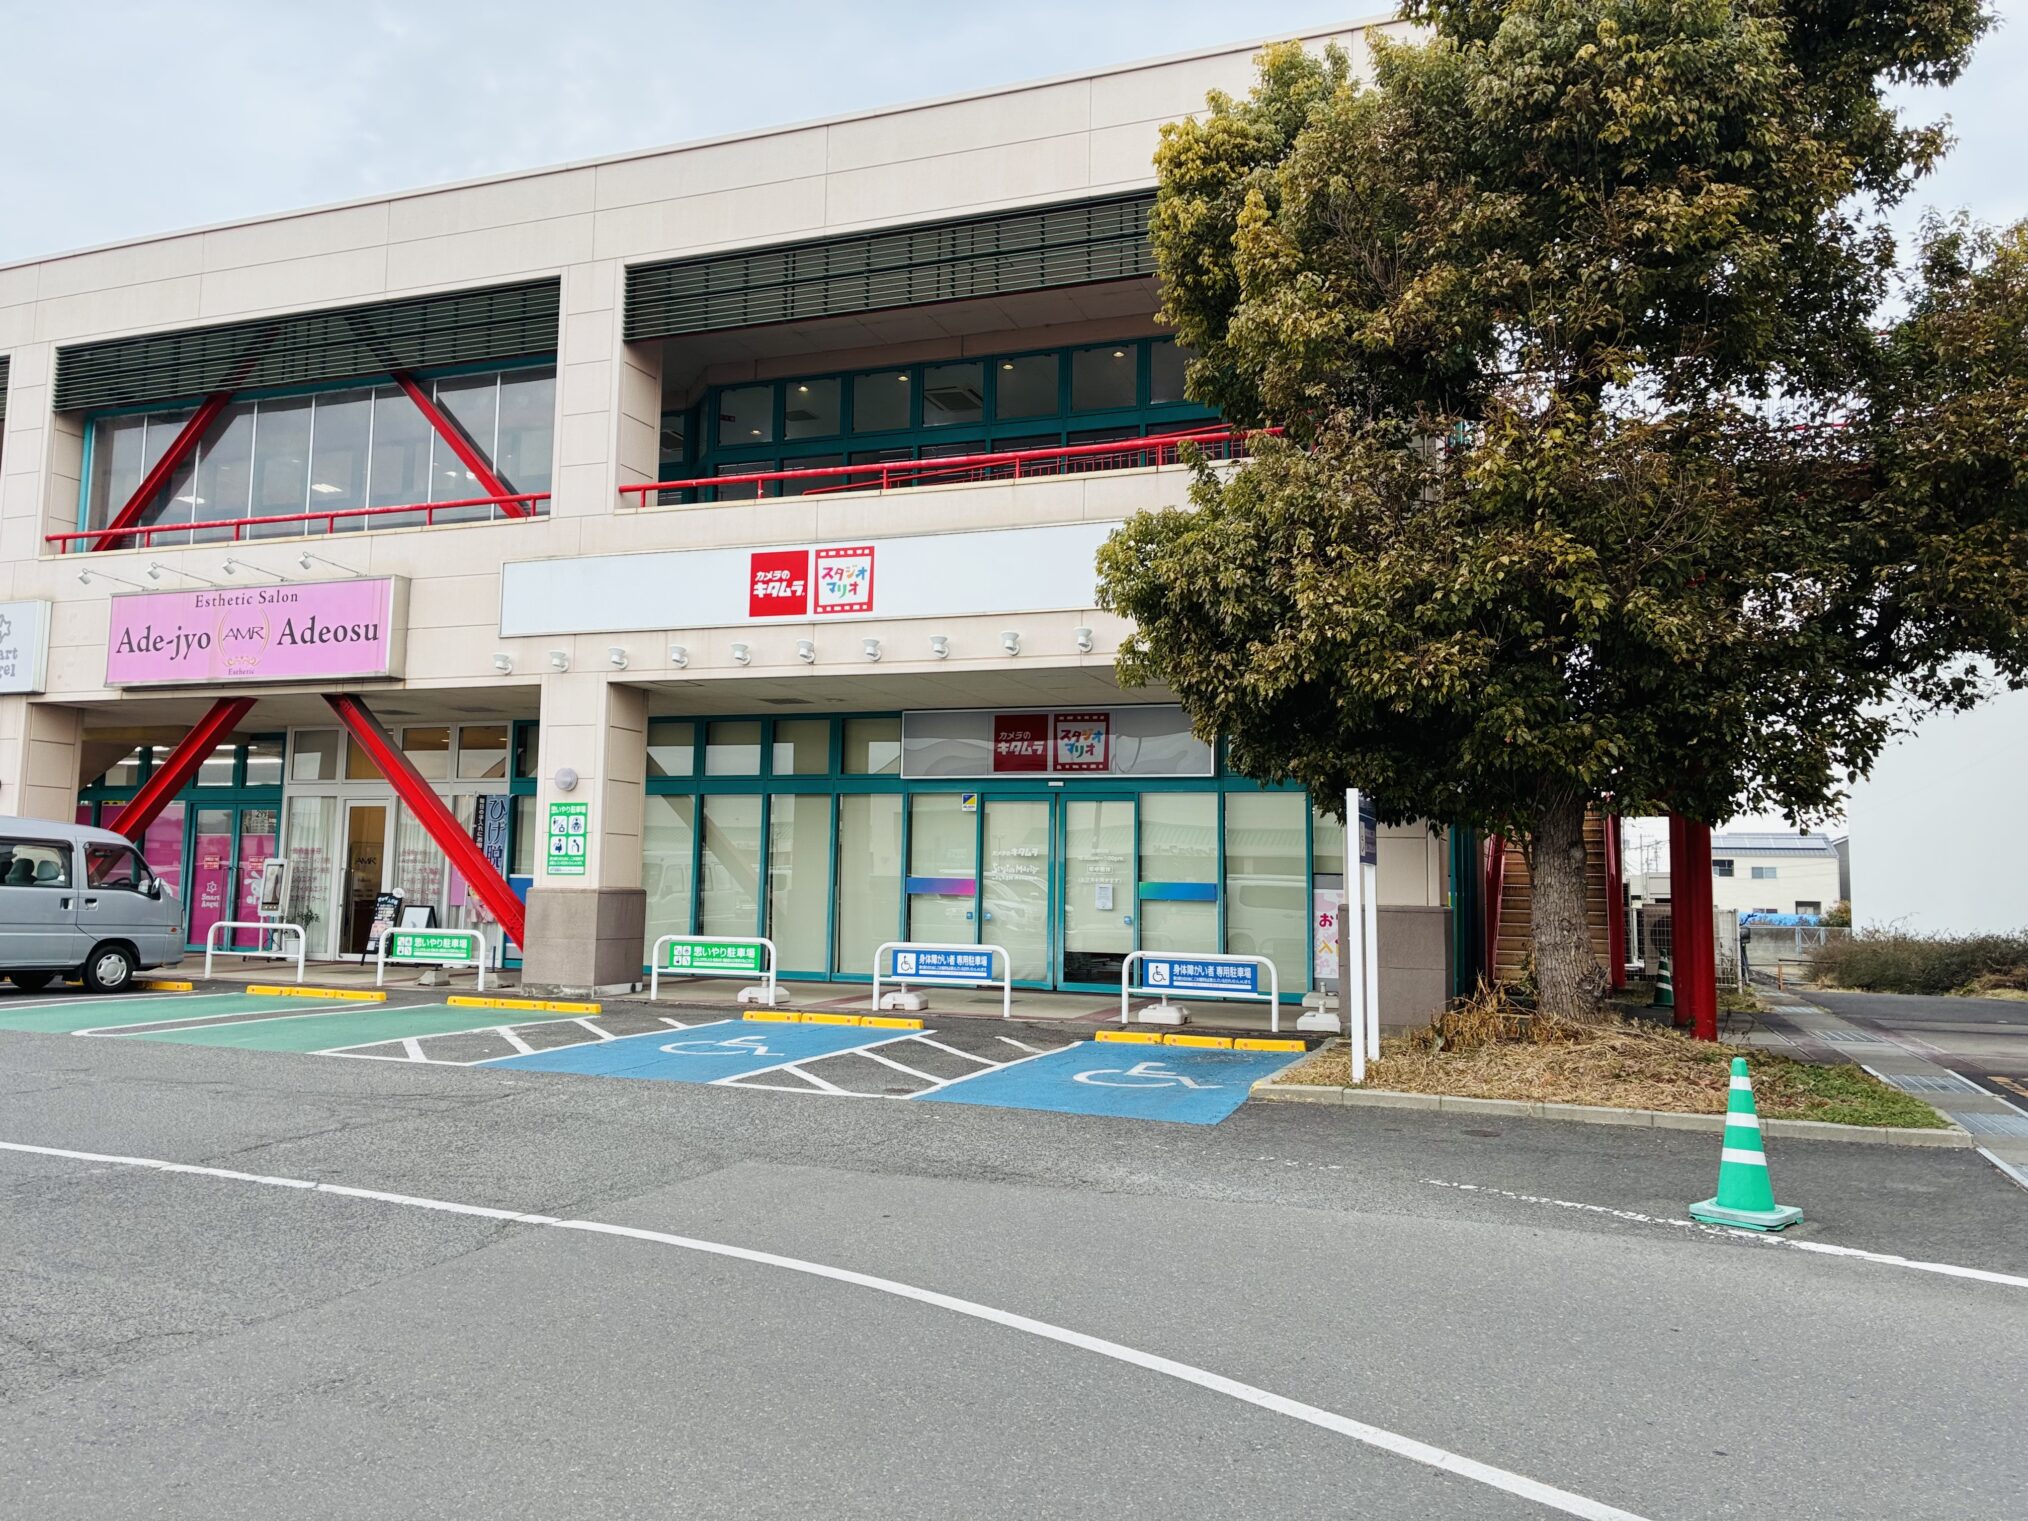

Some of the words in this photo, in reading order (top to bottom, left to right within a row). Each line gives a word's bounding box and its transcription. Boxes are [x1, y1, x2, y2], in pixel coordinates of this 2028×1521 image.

[755, 569, 791, 582] カメラの
[821, 564, 868, 582] スタジオ
[752, 580, 805, 598] キタムラ
[826, 581, 860, 599] マリオ
[195, 593, 254, 608] Esthetic
[258, 589, 299, 604] Salon
[115, 624, 211, 660] Ade-jyo
[222, 626, 265, 641] AMR
[276, 615, 379, 646] Adeosu
[999, 731, 1032, 741] カメラの
[1060, 728, 1104, 743] スタジオ
[996, 740, 1045, 755] キタムラ
[1064, 742, 1096, 759] マリオ
[487, 798, 508, 872] ひげ脱
[693, 945, 756, 958] 思いやり駐車場
